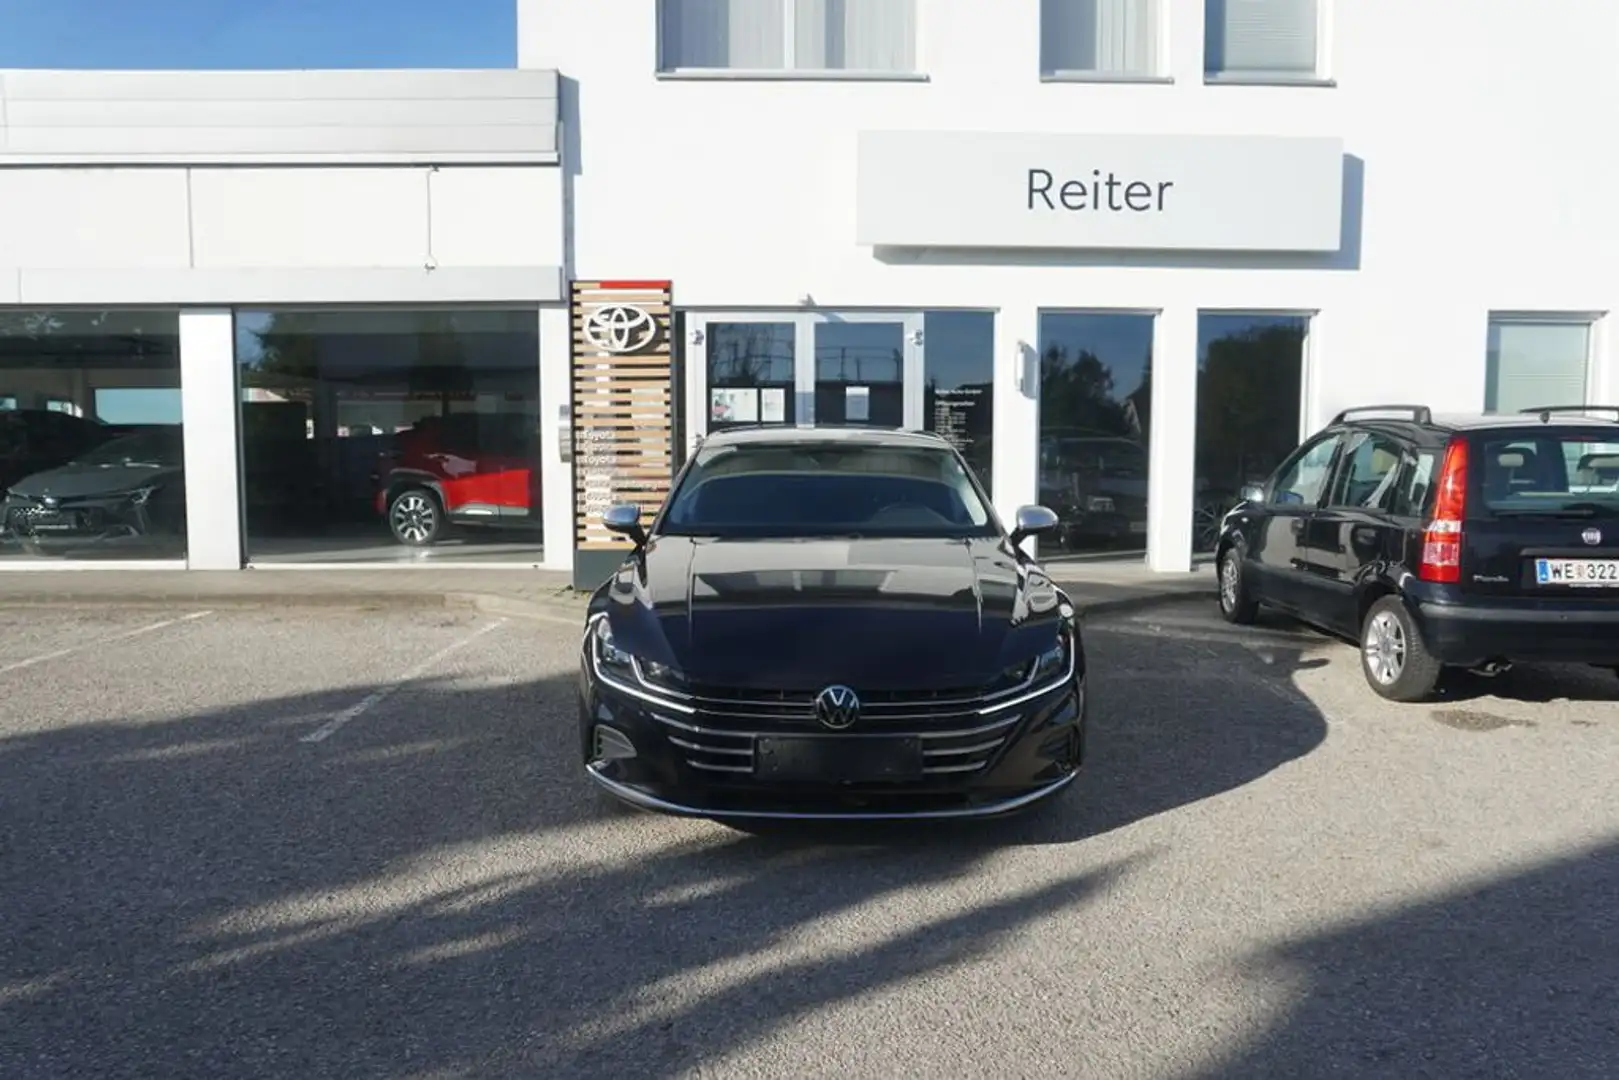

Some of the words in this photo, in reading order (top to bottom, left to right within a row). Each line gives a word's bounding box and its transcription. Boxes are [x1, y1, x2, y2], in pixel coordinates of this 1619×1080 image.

[1028, 168, 1174, 211] Reiter
[1551, 564, 1575, 579] WE
[1587, 563, 1618, 580] 322
